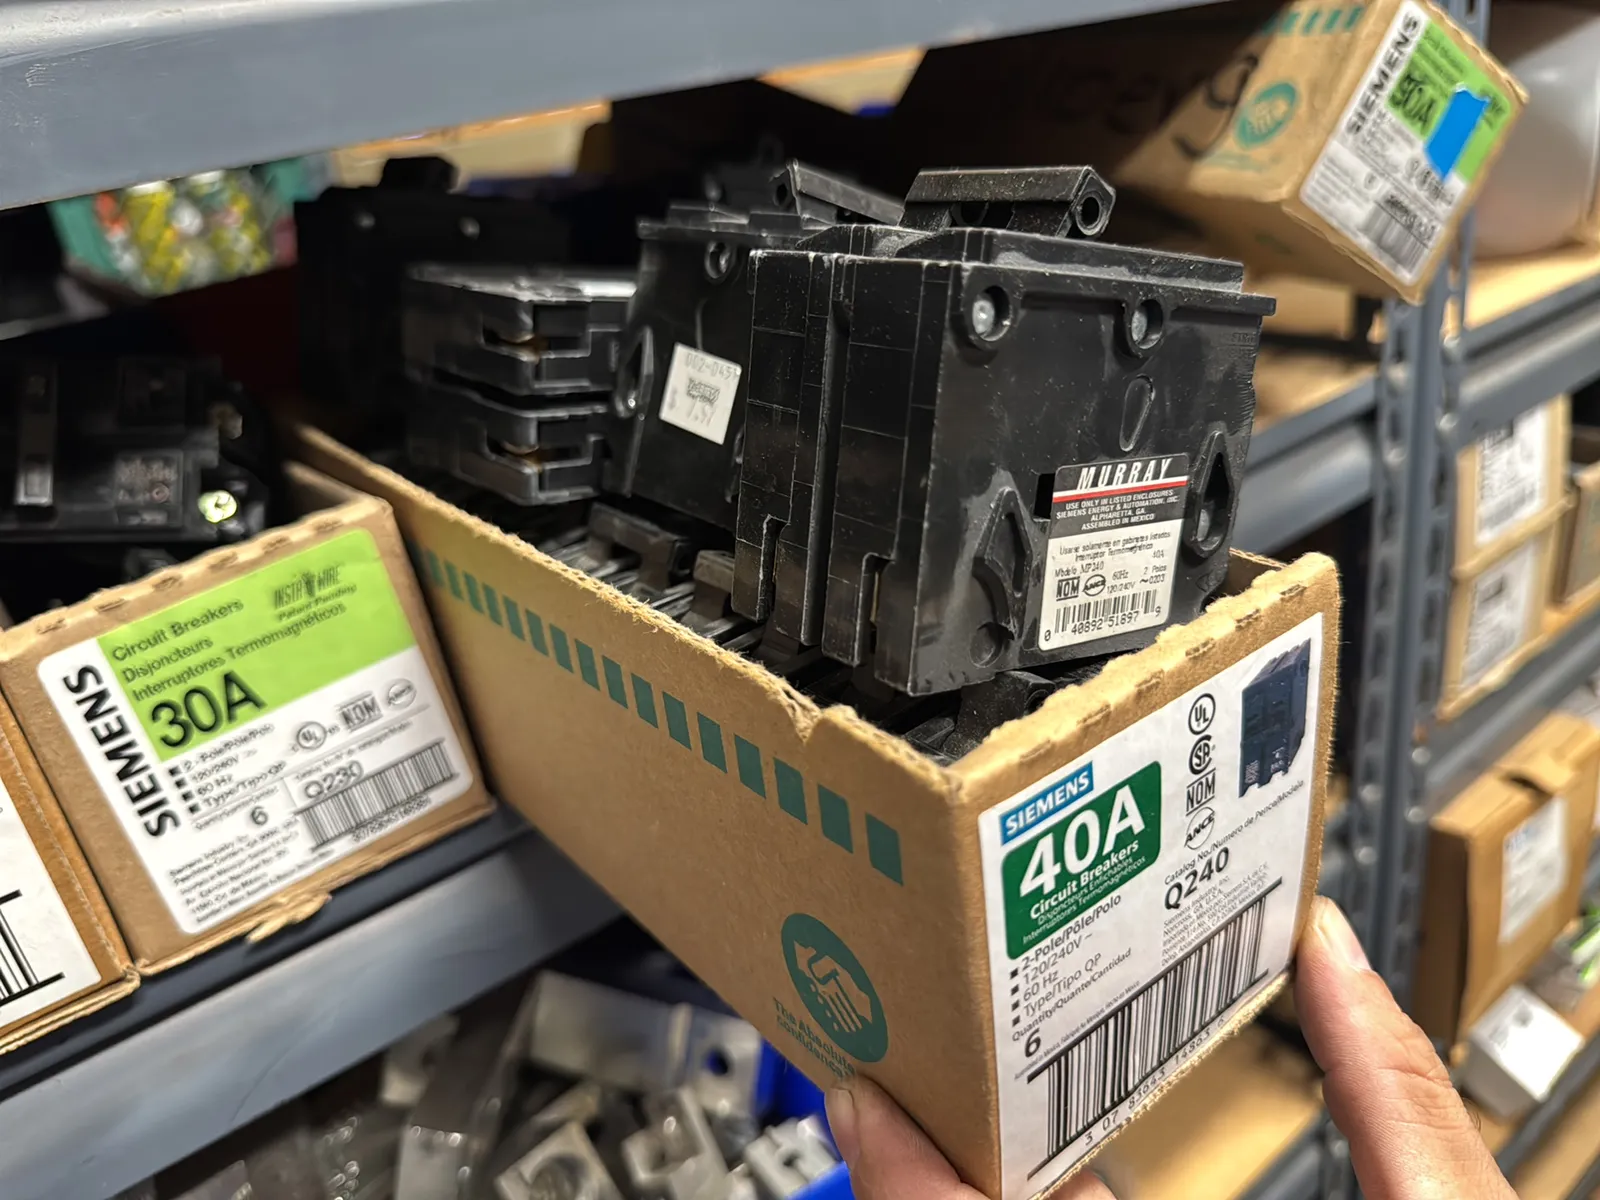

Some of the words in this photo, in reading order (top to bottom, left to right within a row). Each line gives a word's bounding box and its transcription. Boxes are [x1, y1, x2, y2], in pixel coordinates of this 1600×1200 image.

[1346, 12, 1418, 135] SIEMENS
[1076, 457, 1173, 490] MURRAY
[1056, 508, 1087, 519] SIEMENS
[1088, 505, 1114, 515] ENERGY
[1065, 502, 1080, 510] USE
[1080, 500, 1099, 508] ONLY
[1109, 495, 1132, 504] LISTED
[1133, 490, 1173, 500] ENCLOSURES
[1081, 519, 1120, 530] ASSEMBLED
[1130, 513, 1155, 523] MEXICO
[1056, 577, 1080, 598] NOM
[112, 629, 169, 661] Circuit
[170, 599, 244, 637] Breakers
[1044, 630, 1051, 642] 0
[1071, 620, 1103, 636] 40892
[1108, 611, 1139, 627] 51897
[1154, 606, 1161, 618] 9
[122, 637, 214, 683] Disjoncteurs
[132, 656, 226, 701] Interruptores
[226, 602, 347, 660] Termomagnéticos
[151, 670, 268, 747] 30A
[341, 696, 378, 727] NOM
[63, 664, 181, 837] SIEMENS
[304, 759, 364, 800] Q230
[1187, 771, 1216, 813] NOM
[251, 805, 268, 826] 6
[1005, 771, 1090, 836] SIEMENS
[1019, 784, 1145, 898] 40A
[1184, 811, 1215, 847] ANCE
[1030, 879, 1078, 919] Circuit
[1079, 840, 1139, 886] Breakers
[1164, 857, 1197, 886] Catalog
[1164, 846, 1230, 910] Q240
[1037, 883, 1089, 926] Disjoncteurs
[1021, 894, 1122, 972] 2-Pole/Pôle/Polo
[1022, 906, 1078, 946] Interruptores
[1023, 936, 1082, 985] 120/240V
[1023, 971, 1082, 1018] Type/Tipo
[1084, 952, 1102, 974] QP
[1023, 983, 1040, 1002] 60
[1042, 970, 1060, 988] Hz
[1025, 1027, 1042, 1058] 6
[1085, 1132, 1094, 1146] 3
[1102, 1109, 1119, 1131] 07
